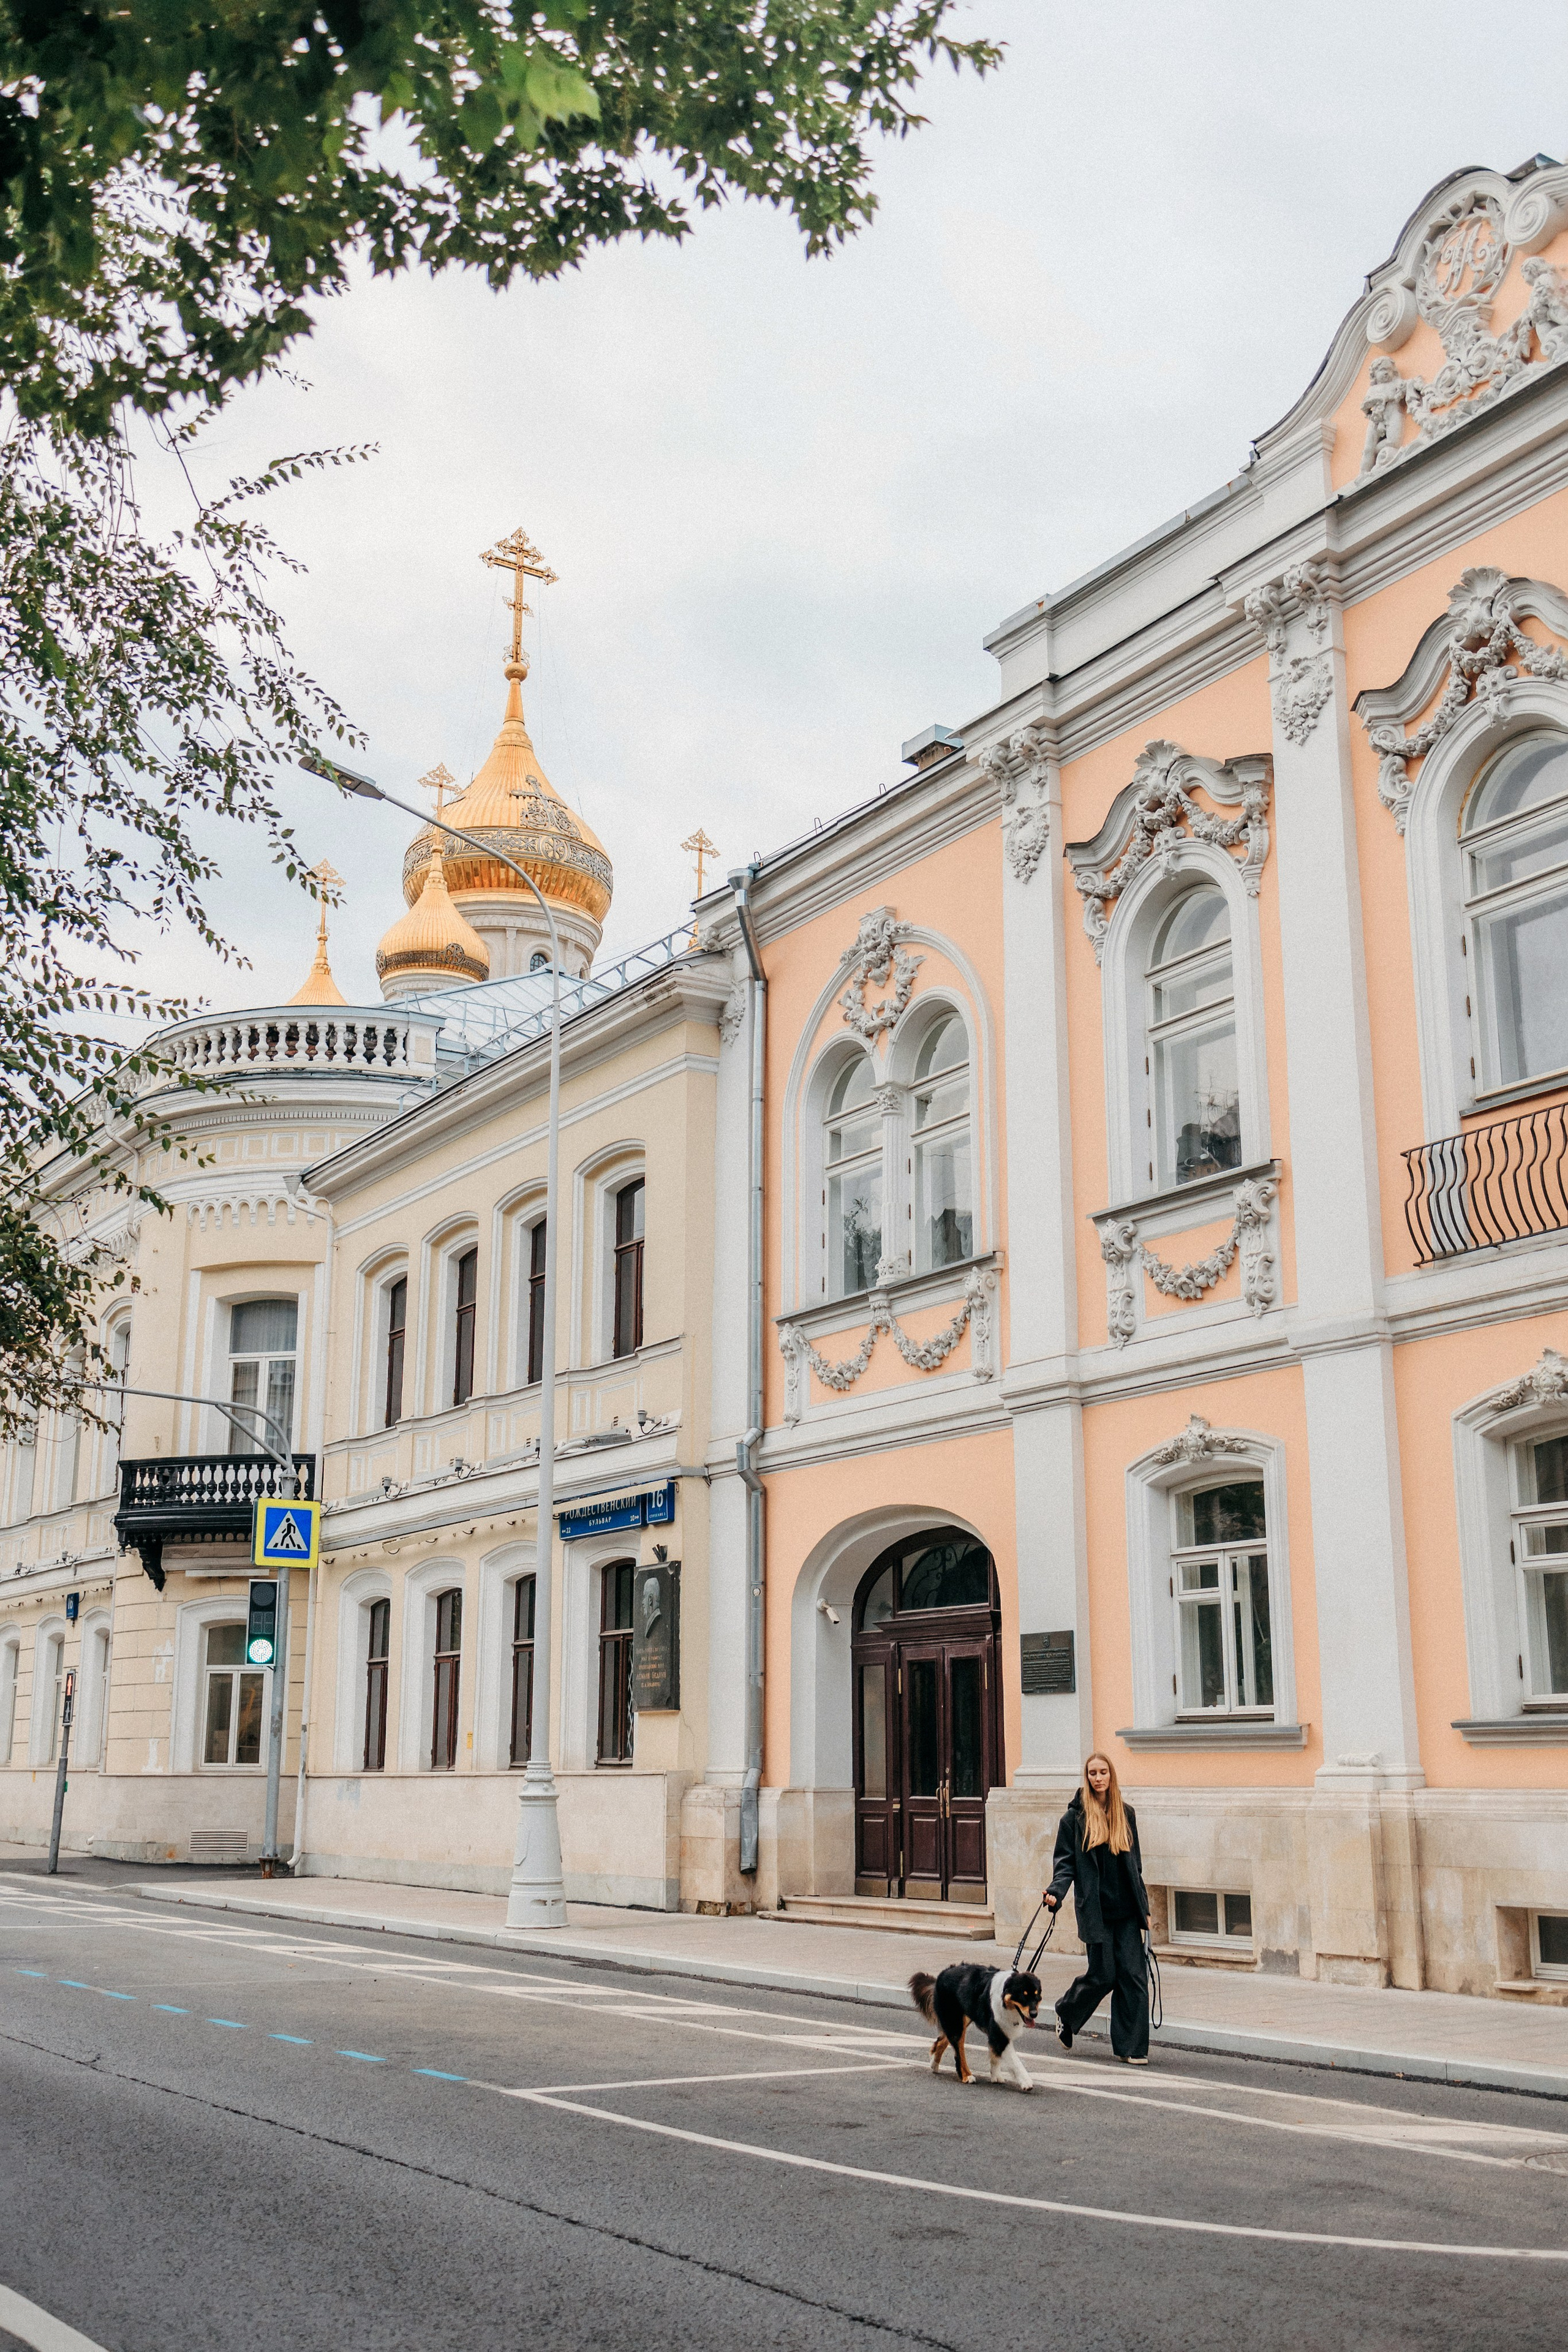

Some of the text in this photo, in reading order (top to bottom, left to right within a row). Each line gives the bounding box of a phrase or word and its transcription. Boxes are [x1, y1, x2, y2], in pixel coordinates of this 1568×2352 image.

[651, 1489, 663, 1508] 16
[589, 1516, 612, 1526] БУЛЬВАР
[68, 1596, 74, 1609] 16
